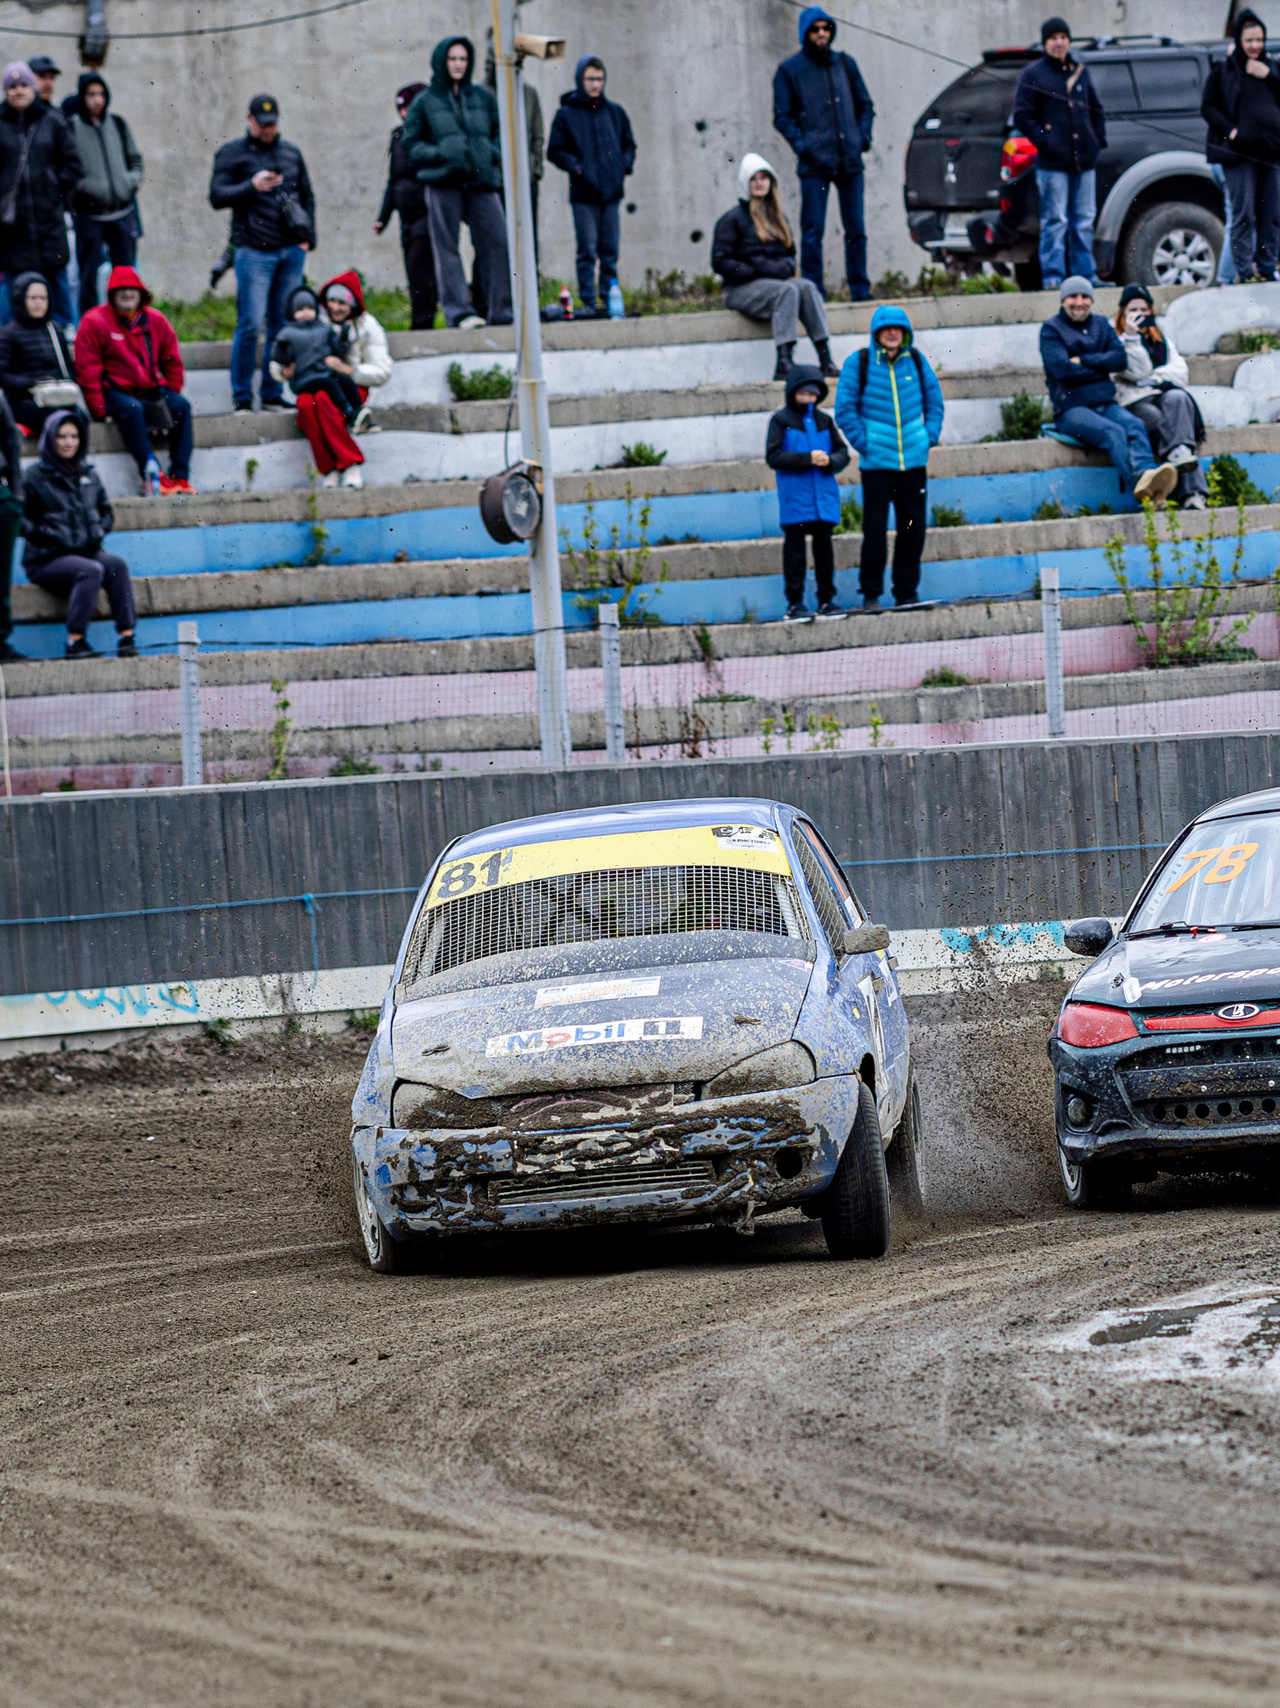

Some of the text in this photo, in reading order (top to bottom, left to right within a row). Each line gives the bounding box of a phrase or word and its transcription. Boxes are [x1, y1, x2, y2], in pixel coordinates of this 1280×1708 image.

[437, 852, 502, 898] 81
[1164, 842, 1259, 894] 78
[507, 1022, 625, 1051] Mobil
